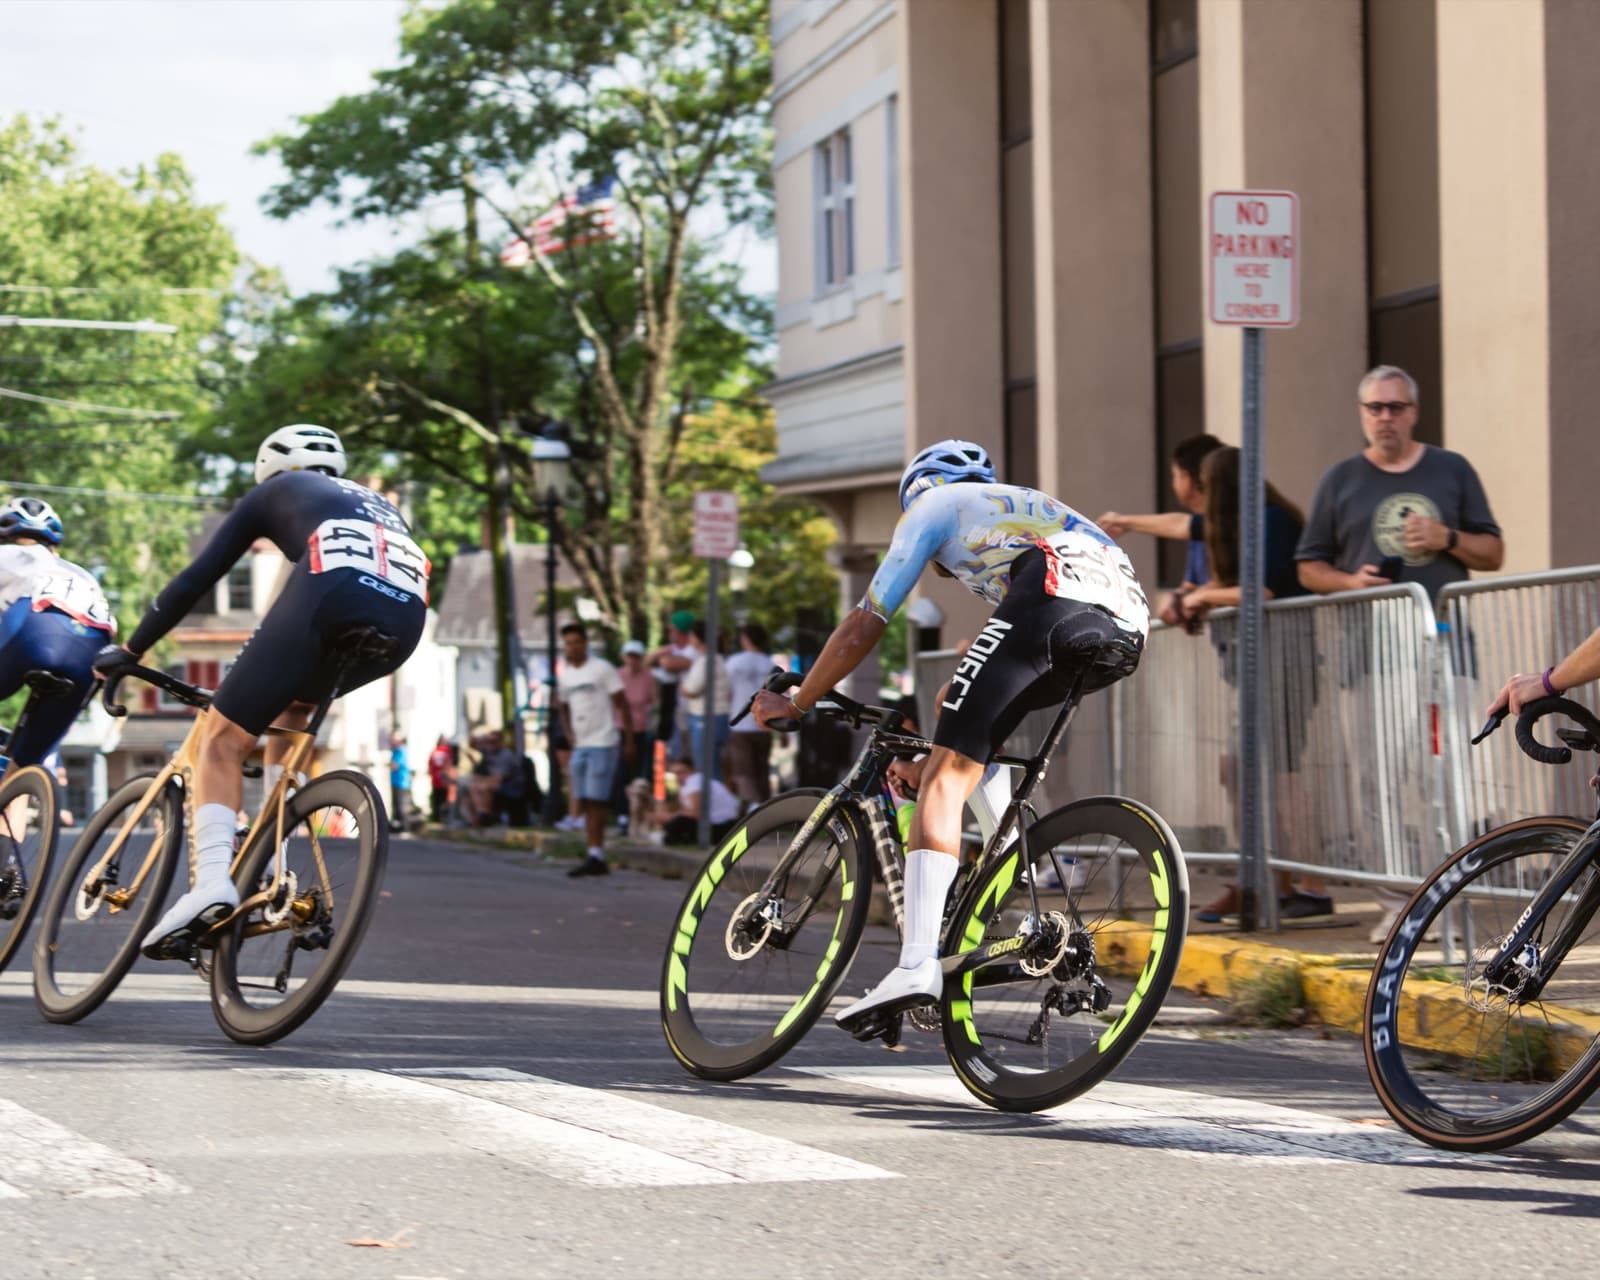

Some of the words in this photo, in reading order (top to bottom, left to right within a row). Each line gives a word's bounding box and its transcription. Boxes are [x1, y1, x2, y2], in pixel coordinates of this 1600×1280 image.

[1236, 201, 1269, 226] NO
[1212, 232, 1295, 259] PARKING
[1234, 263, 1273, 279] HERE
[1244, 283, 1262, 298] TO
[1225, 302, 1280, 318] CORNER
[987, 934, 1025, 958] OSTRO
[1373, 912, 1423, 1050] BLACK
[1427, 848, 1483, 902] INC
